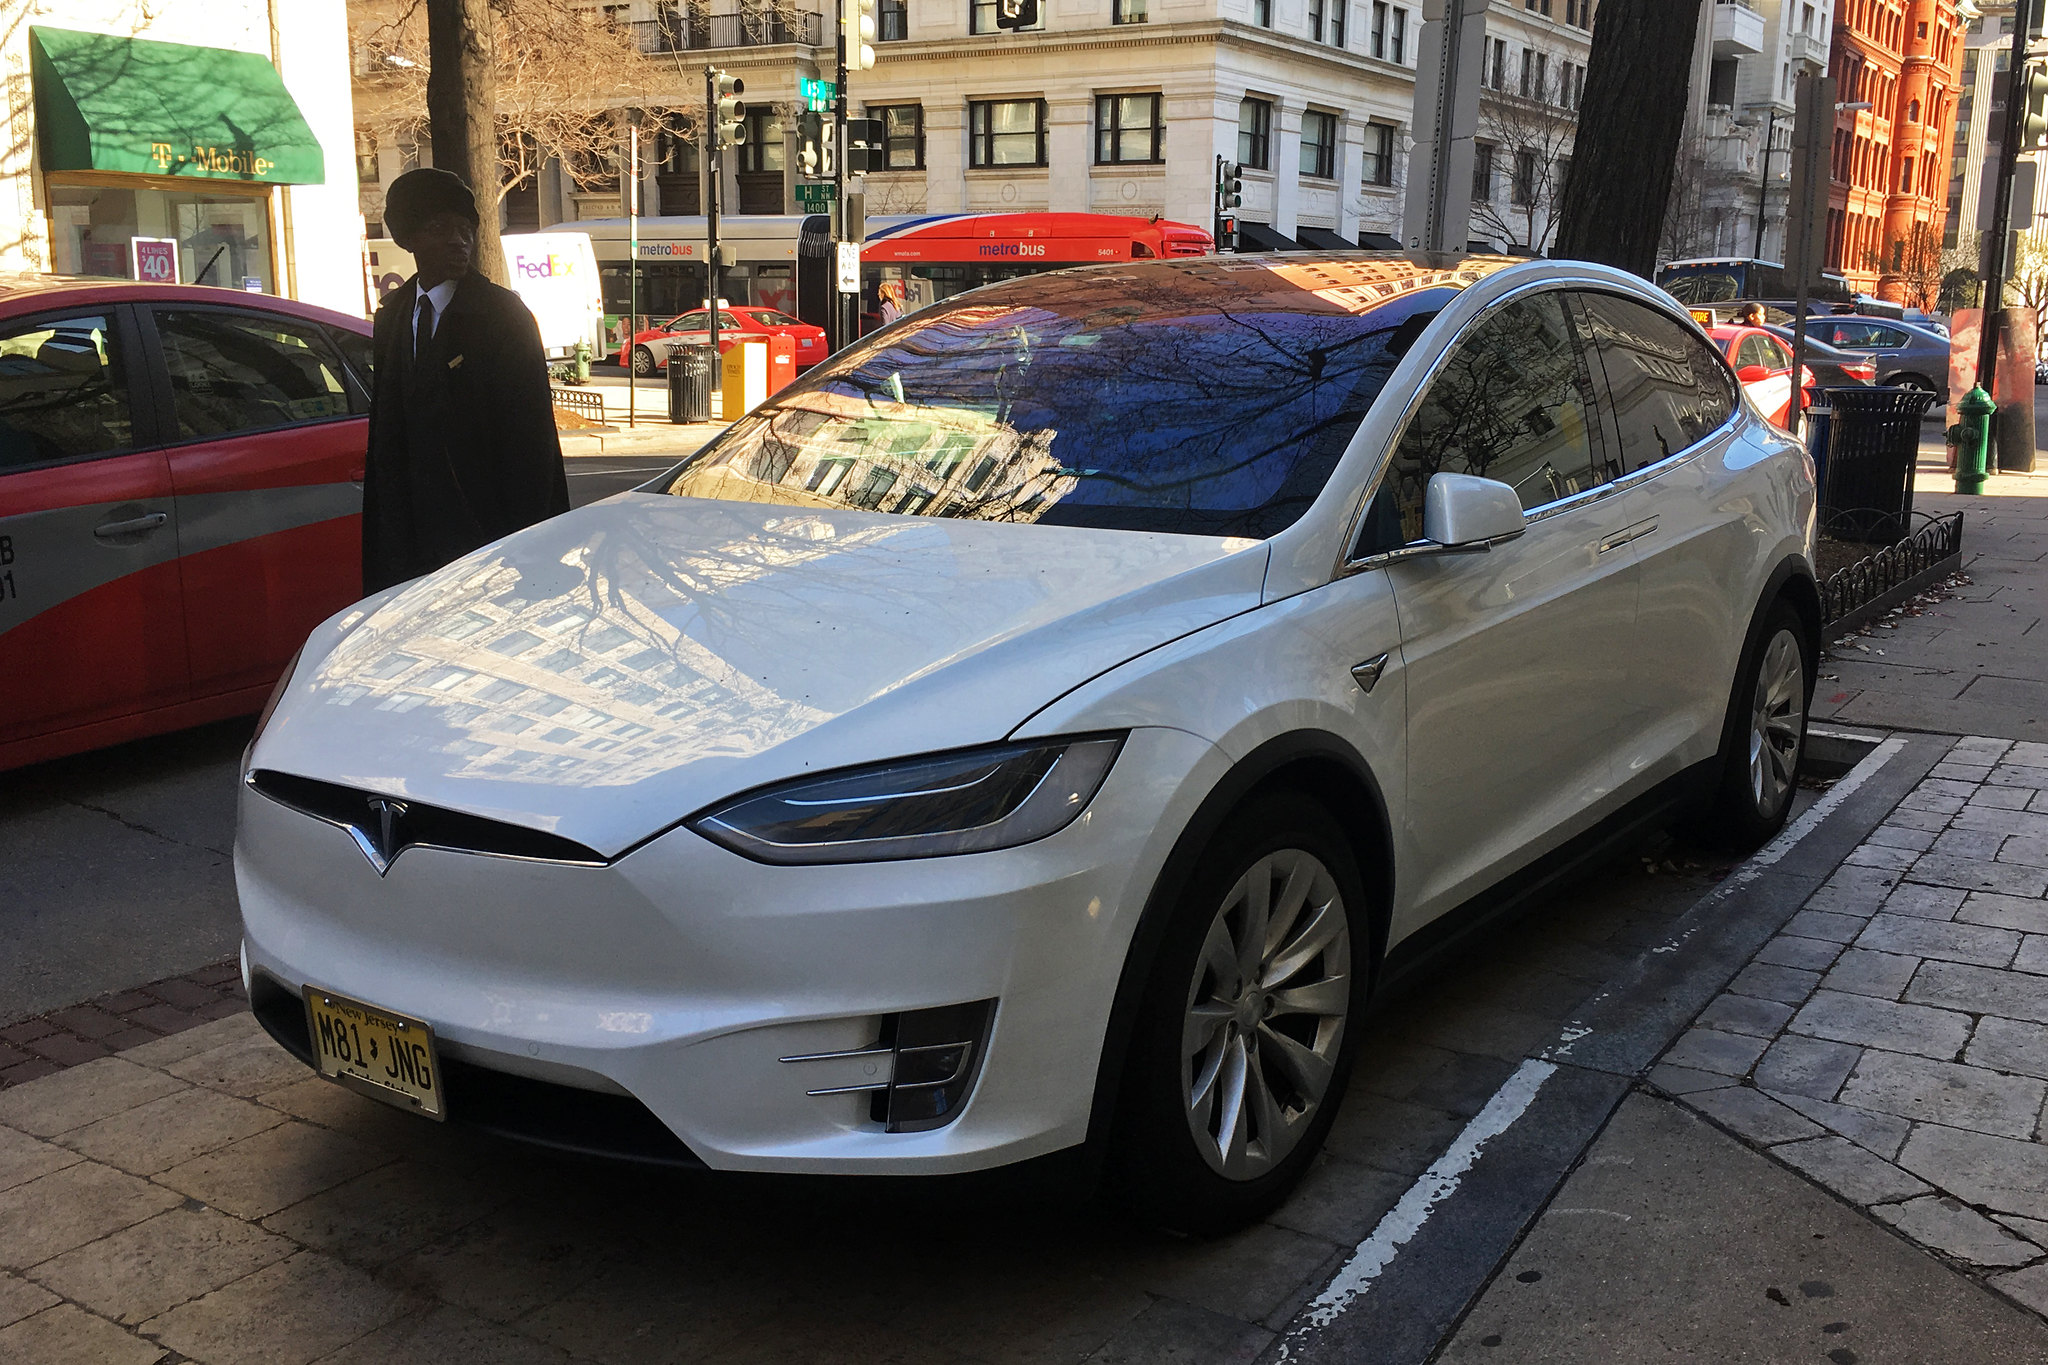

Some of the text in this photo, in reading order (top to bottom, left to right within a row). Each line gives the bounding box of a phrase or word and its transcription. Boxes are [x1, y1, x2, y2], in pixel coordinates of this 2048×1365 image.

[804, 185, 829, 199] H ST
[821, 192, 831, 200] NW
[807, 203, 826, 213] 1400
[640, 243, 693, 256] metrobus
[841, 247, 856, 259] ONE
[979, 241, 1046, 256] metrobus
[1097, 248, 1114, 256] 5401
[516, 254, 575, 279] FedEx
[840, 261, 857, 271] WAY
[335, 1002, 400, 1035] New Jersey
[317, 1011, 368, 1069] M81
[385, 1035, 432, 1090] JNG
